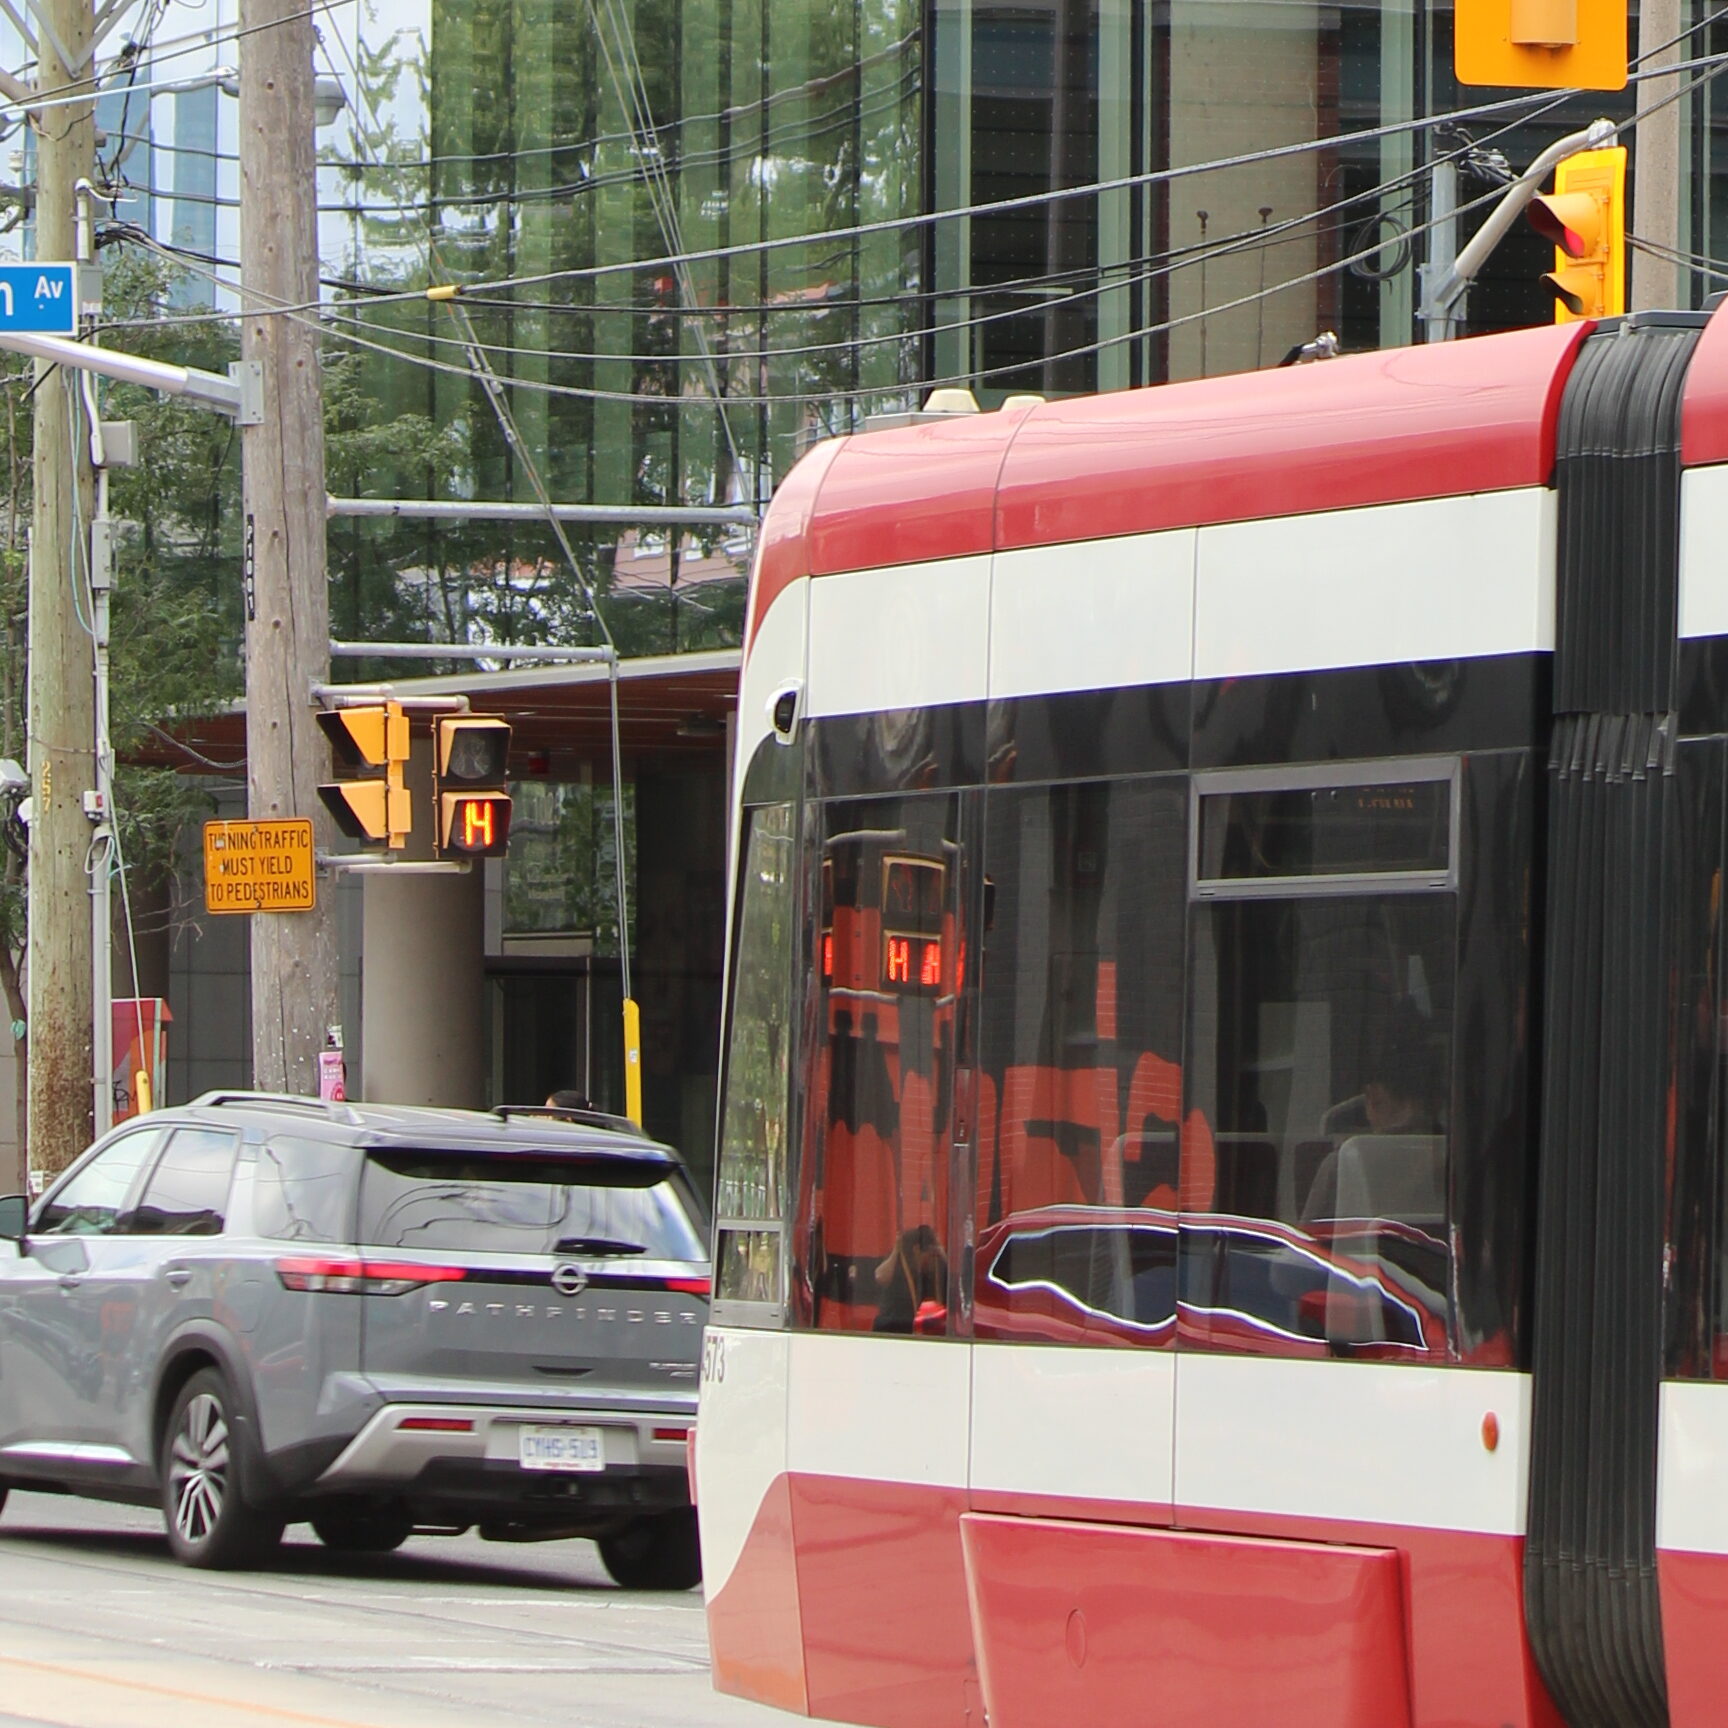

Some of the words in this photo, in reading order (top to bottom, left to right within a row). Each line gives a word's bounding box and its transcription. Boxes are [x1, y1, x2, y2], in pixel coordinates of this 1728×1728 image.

[34, 275, 64, 299] Av
[41, 759, 52, 811] 257
[258, 829, 309, 850] TRAFFIC
[222, 857, 255, 877] MUST
[258, 855, 293, 875] YIELD
[210, 883, 224, 902] TO
[227, 880, 309, 902] PEDESTRIANS
[429, 1300, 697, 1325] PATHFINDER
[701, 1335, 725, 1384] 573
